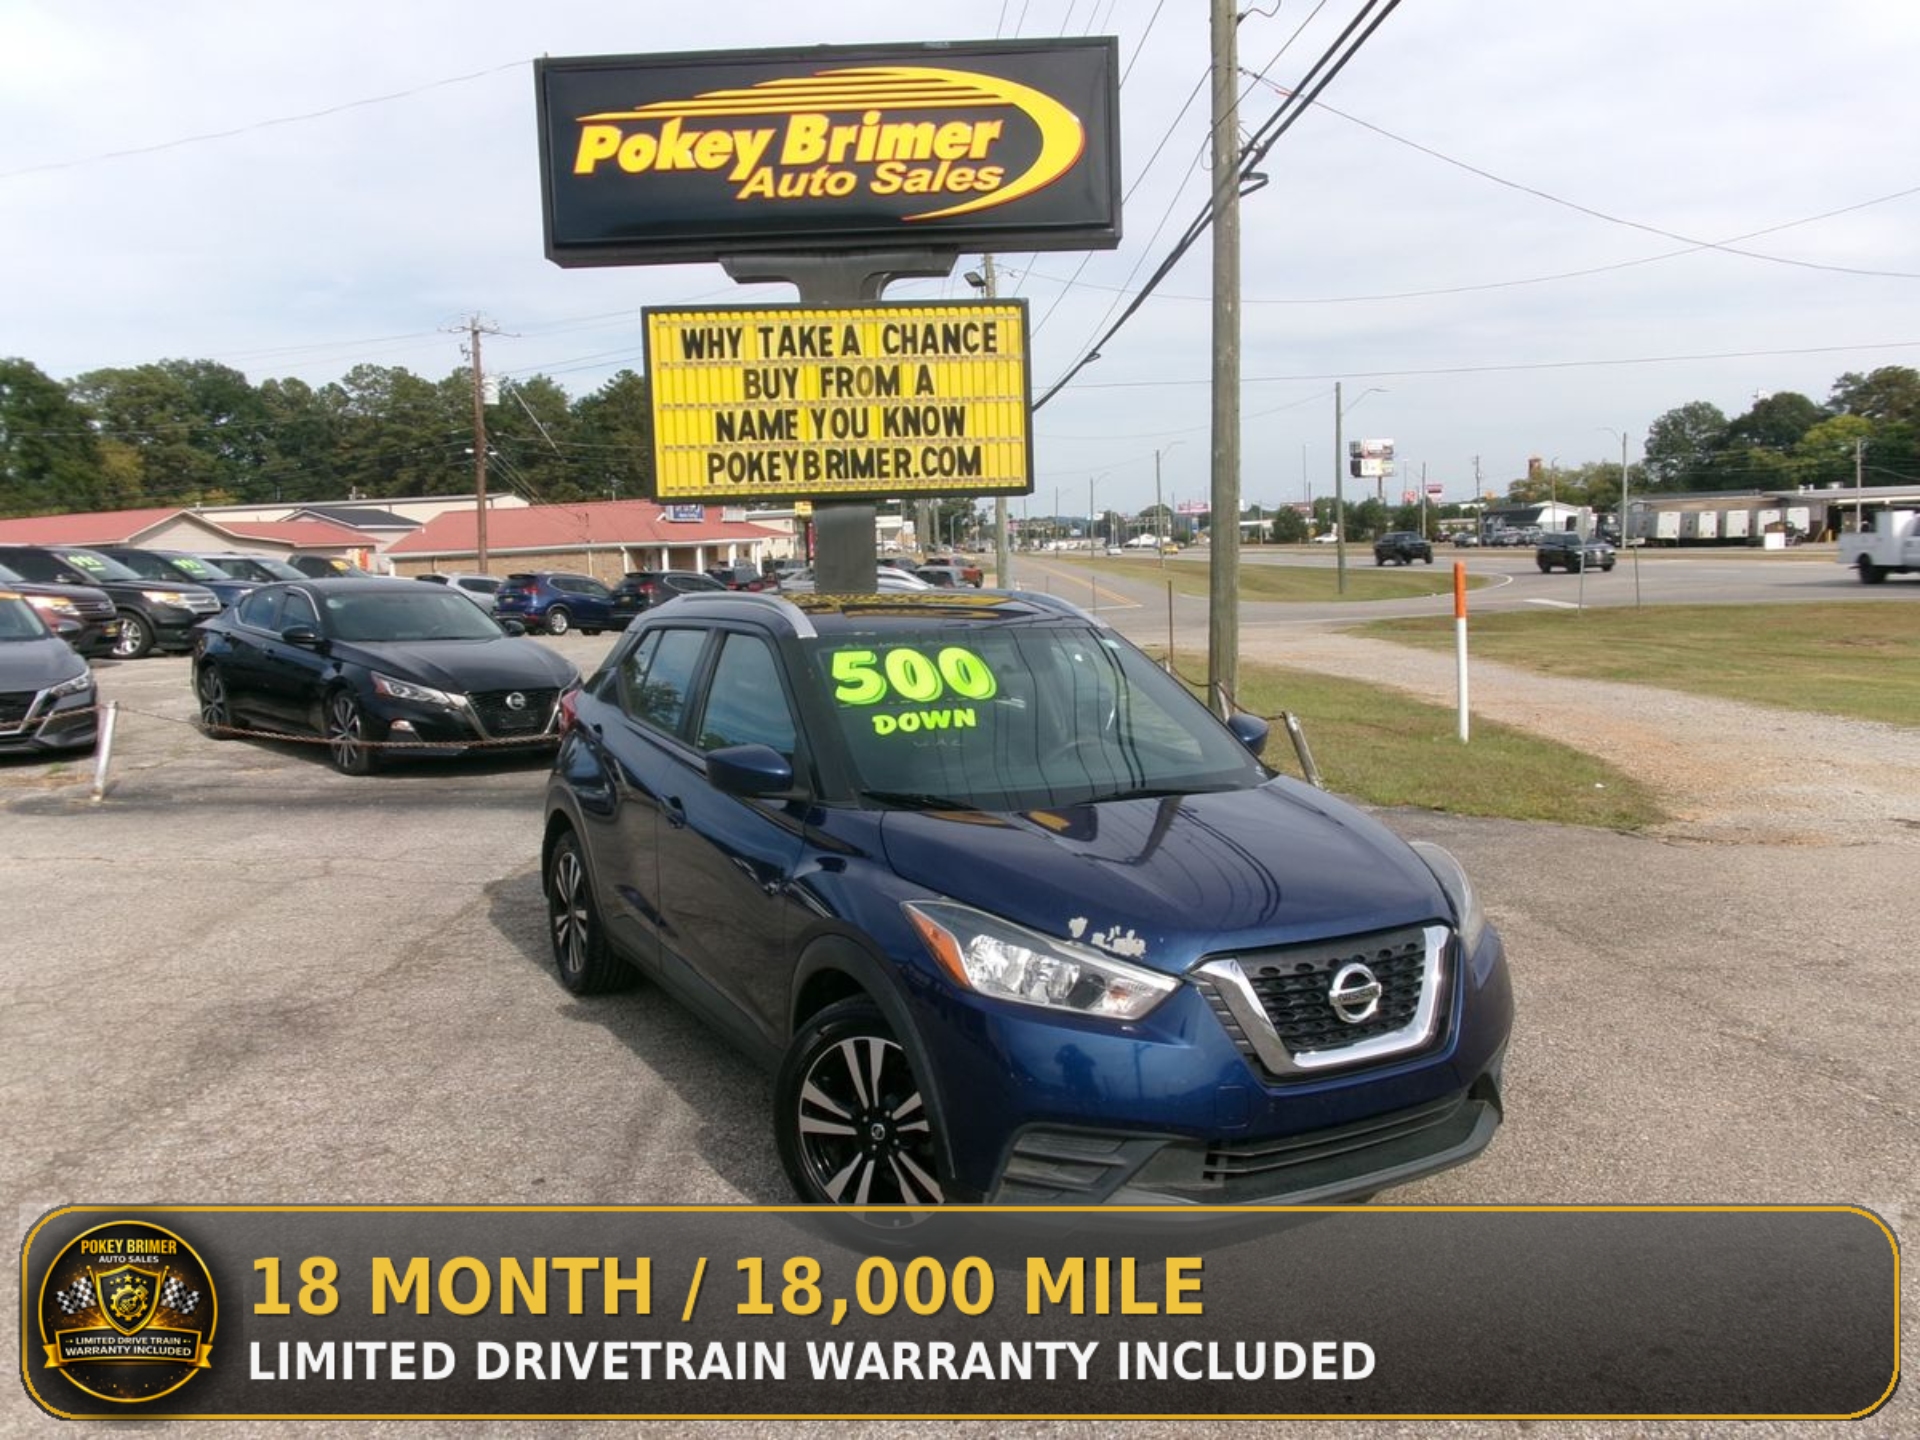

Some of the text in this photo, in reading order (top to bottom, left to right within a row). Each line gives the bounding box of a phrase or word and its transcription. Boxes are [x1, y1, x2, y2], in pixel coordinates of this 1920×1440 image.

[574, 110, 1004, 182] Pokey Brimer
[737, 160, 1005, 200] Auto Sales
[681, 322, 997, 360] WHY TAKE A CHANCE
[744, 365, 935, 400] BUY FROM A
[716, 405, 966, 442] NAME YOU KNOW
[708, 445, 982, 484] POKEYBRIMER.COM
[832, 647, 997, 705] 500
[872, 708, 976, 735] DOWN
